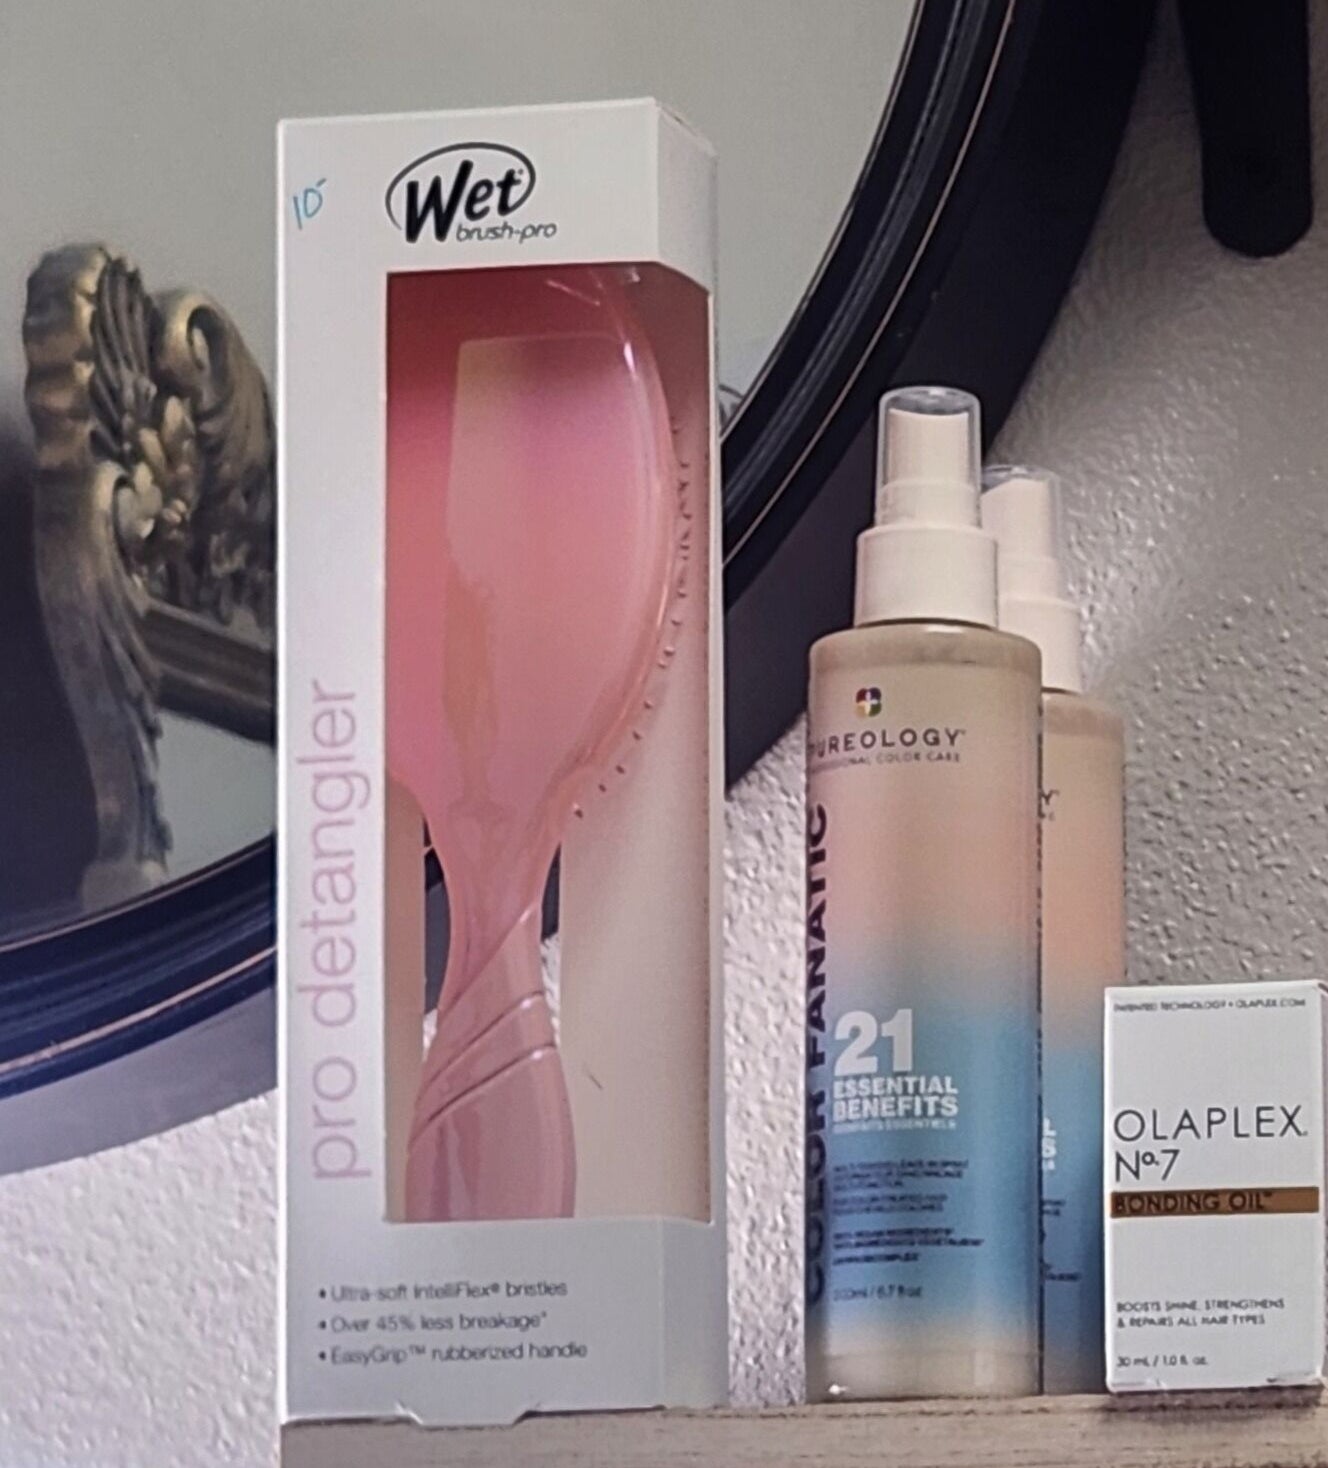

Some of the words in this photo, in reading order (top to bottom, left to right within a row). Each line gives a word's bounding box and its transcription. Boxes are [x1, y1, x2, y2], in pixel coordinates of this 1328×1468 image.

[405, 159, 522, 244] Wet
[456, 221, 557, 244] brush-pro
[808, 728, 961, 758] UREOLOGY
[297, 679, 370, 1027] detangler
[805, 803, 827, 1070] FANATIC
[834, 1008, 913, 1077] 21
[833, 1076, 958, 1099] ESSENTIAL
[313, 1057, 371, 1180] pro
[833, 1096, 958, 1122] BENEFITS
[1115, 1192, 1220, 1213] BONDING
[506, 1280, 567, 1297] bristles
[1117, 1301, 1161, 1312] BOOSTS
[1205, 1298, 1285, 1310] STRENGTHENS
[331, 1317, 370, 1332] Over
[377, 1316, 415, 1331] 45%
[421, 1314, 454, 1329] less
[1117, 1317, 1126, 1328] &
[1130, 1316, 1173, 1327] REPAIRS
[1177, 1316, 1198, 1326] ALL
[1201, 1315, 1228, 1325] HAIR
[1232, 1314, 1266, 1325] TYPES
[432, 1342, 523, 1361] rubberized
[529, 1341, 588, 1359] handle
[1117, 1356, 1131, 1367] 30
